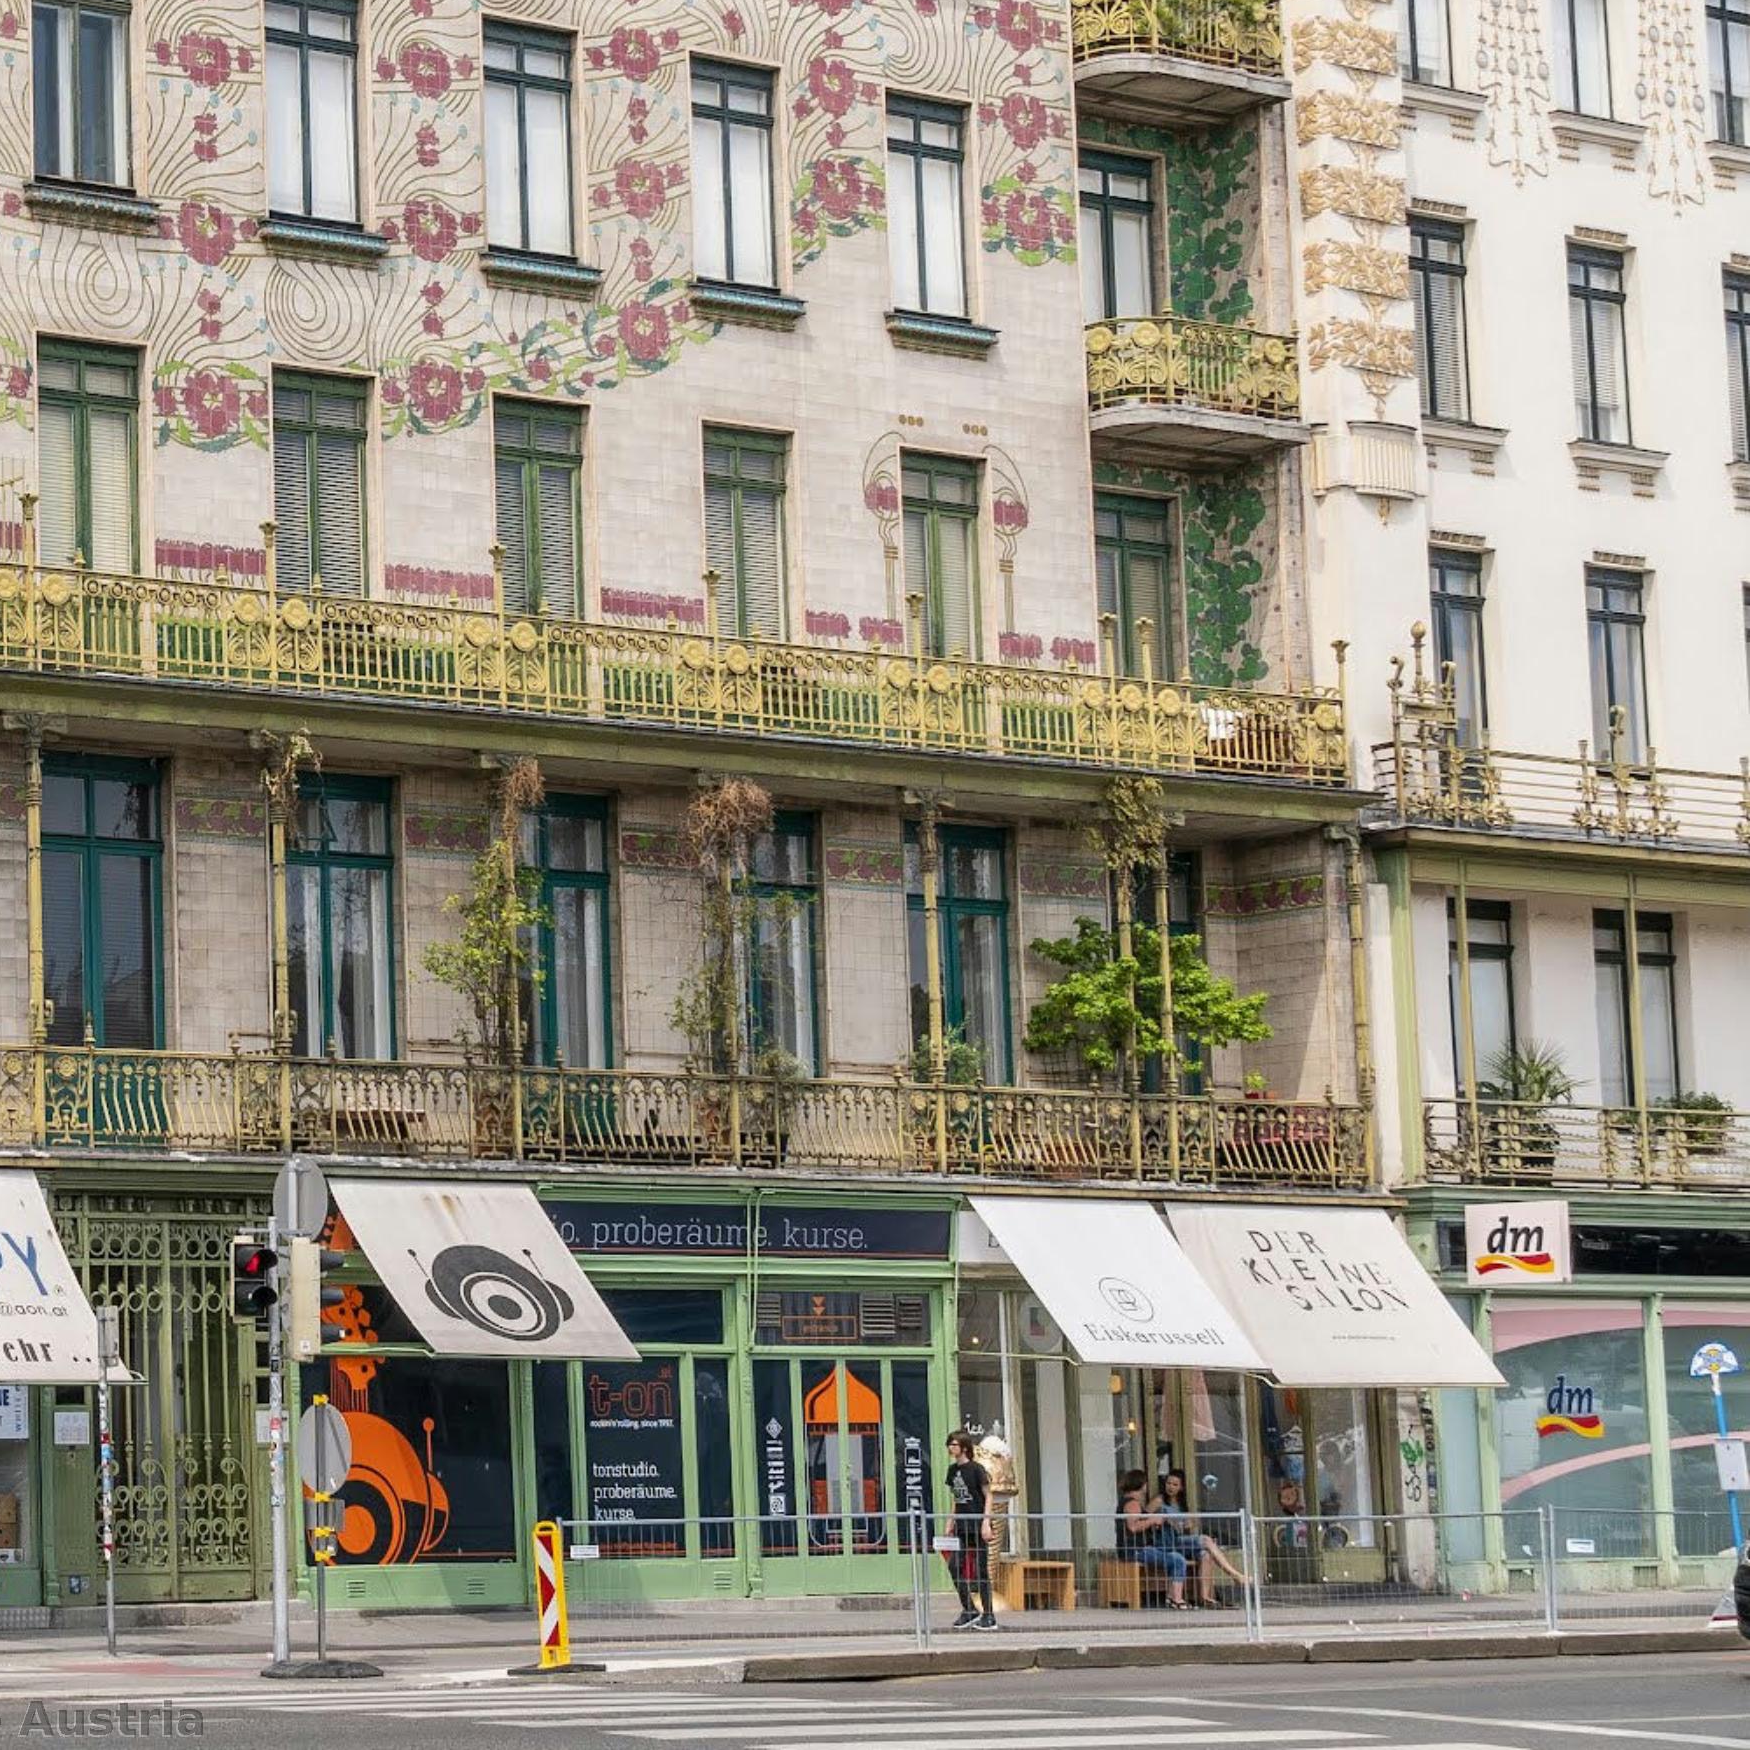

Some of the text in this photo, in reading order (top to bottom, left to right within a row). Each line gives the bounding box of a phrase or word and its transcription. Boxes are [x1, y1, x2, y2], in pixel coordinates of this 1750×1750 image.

[591, 1215, 771, 1250] proberäume.
[782, 1218, 868, 1250] kurse.
[1247, 1230, 1324, 1254] DER
[1487, 1217, 1545, 1254] dm
[1242, 1258, 1393, 1285] KLEINE
[1285, 1285, 1410, 1311] SALON
[1083, 1324, 1226, 1346] Eiskarussell
[589, 1374, 673, 1418] t-on
[1546, 1376, 1593, 1415] dm
[592, 1461, 660, 1478] tonstudio.
[593, 1484, 678, 1502] proberäume.
[594, 1505, 636, 1521] kurse.
